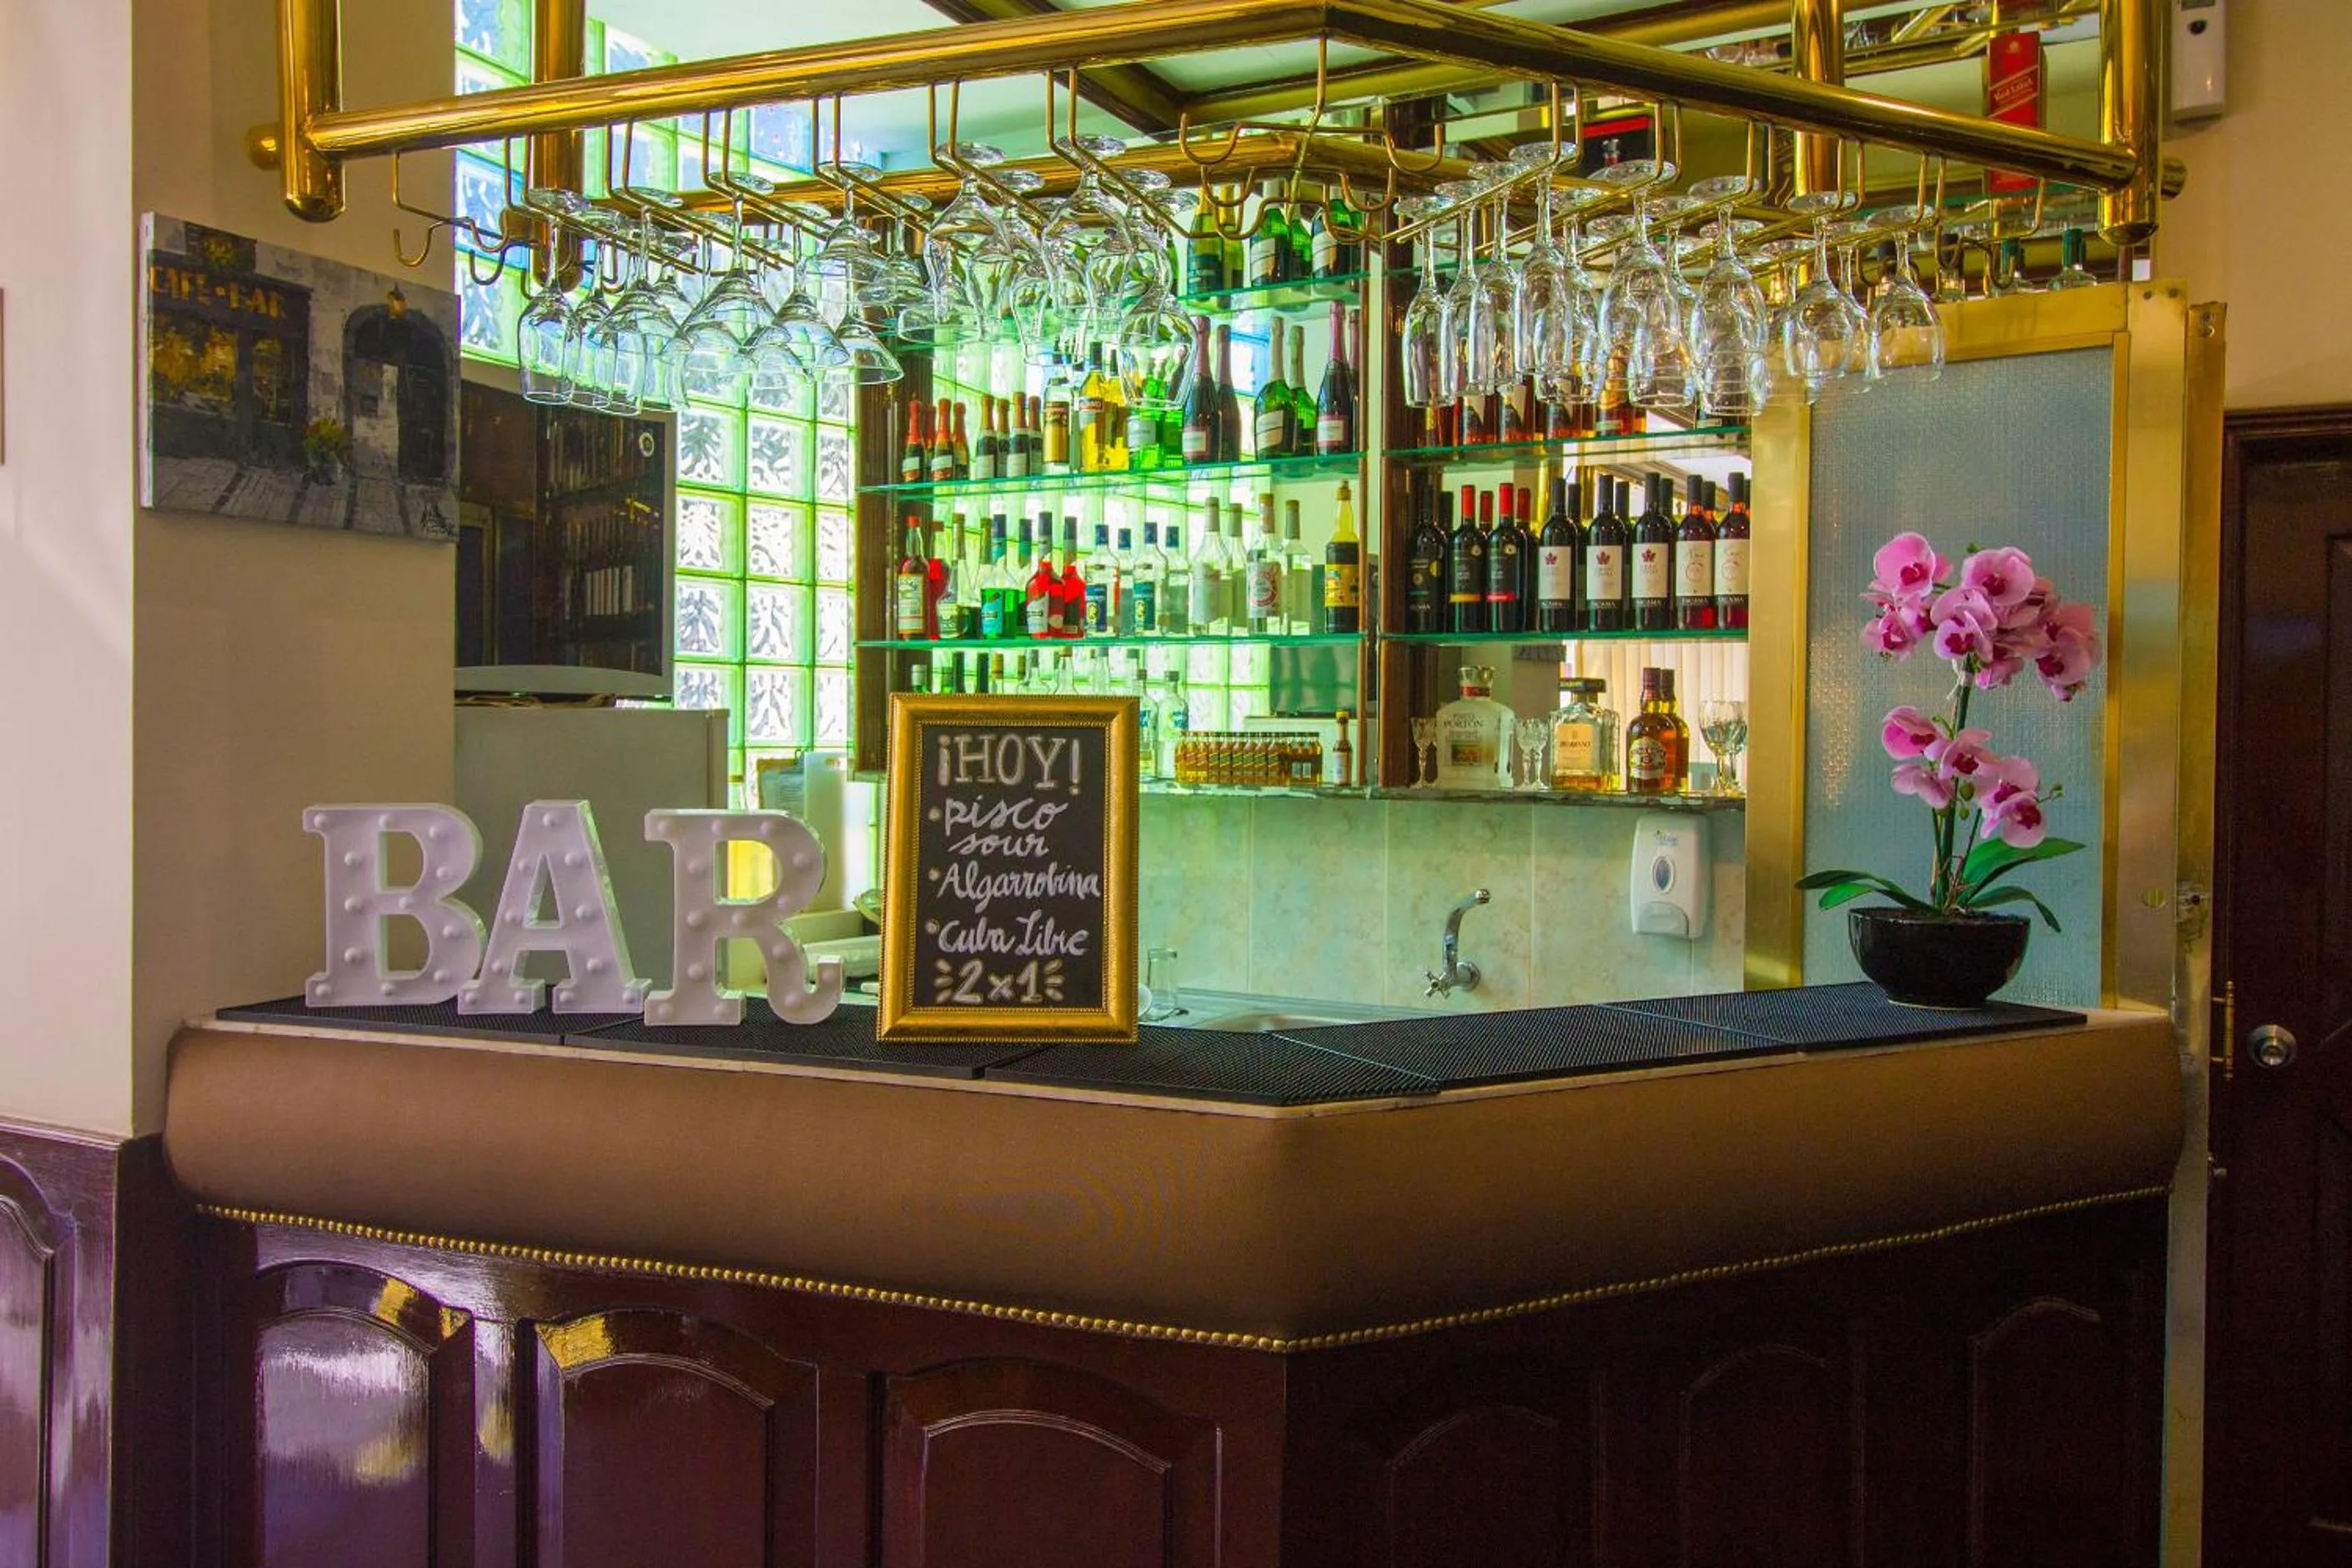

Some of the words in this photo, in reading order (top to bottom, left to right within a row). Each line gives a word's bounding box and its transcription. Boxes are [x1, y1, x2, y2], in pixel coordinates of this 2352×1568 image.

[937, 733, 1082, 795] ¡HOY!
[947, 834, 1050, 857] sour
[303, 800, 844, 1026] BAR
[937, 862, 1102, 914] Algarrobina
[937, 917, 1015, 954] Cuba
[1013, 909, 1090, 956] Libre
